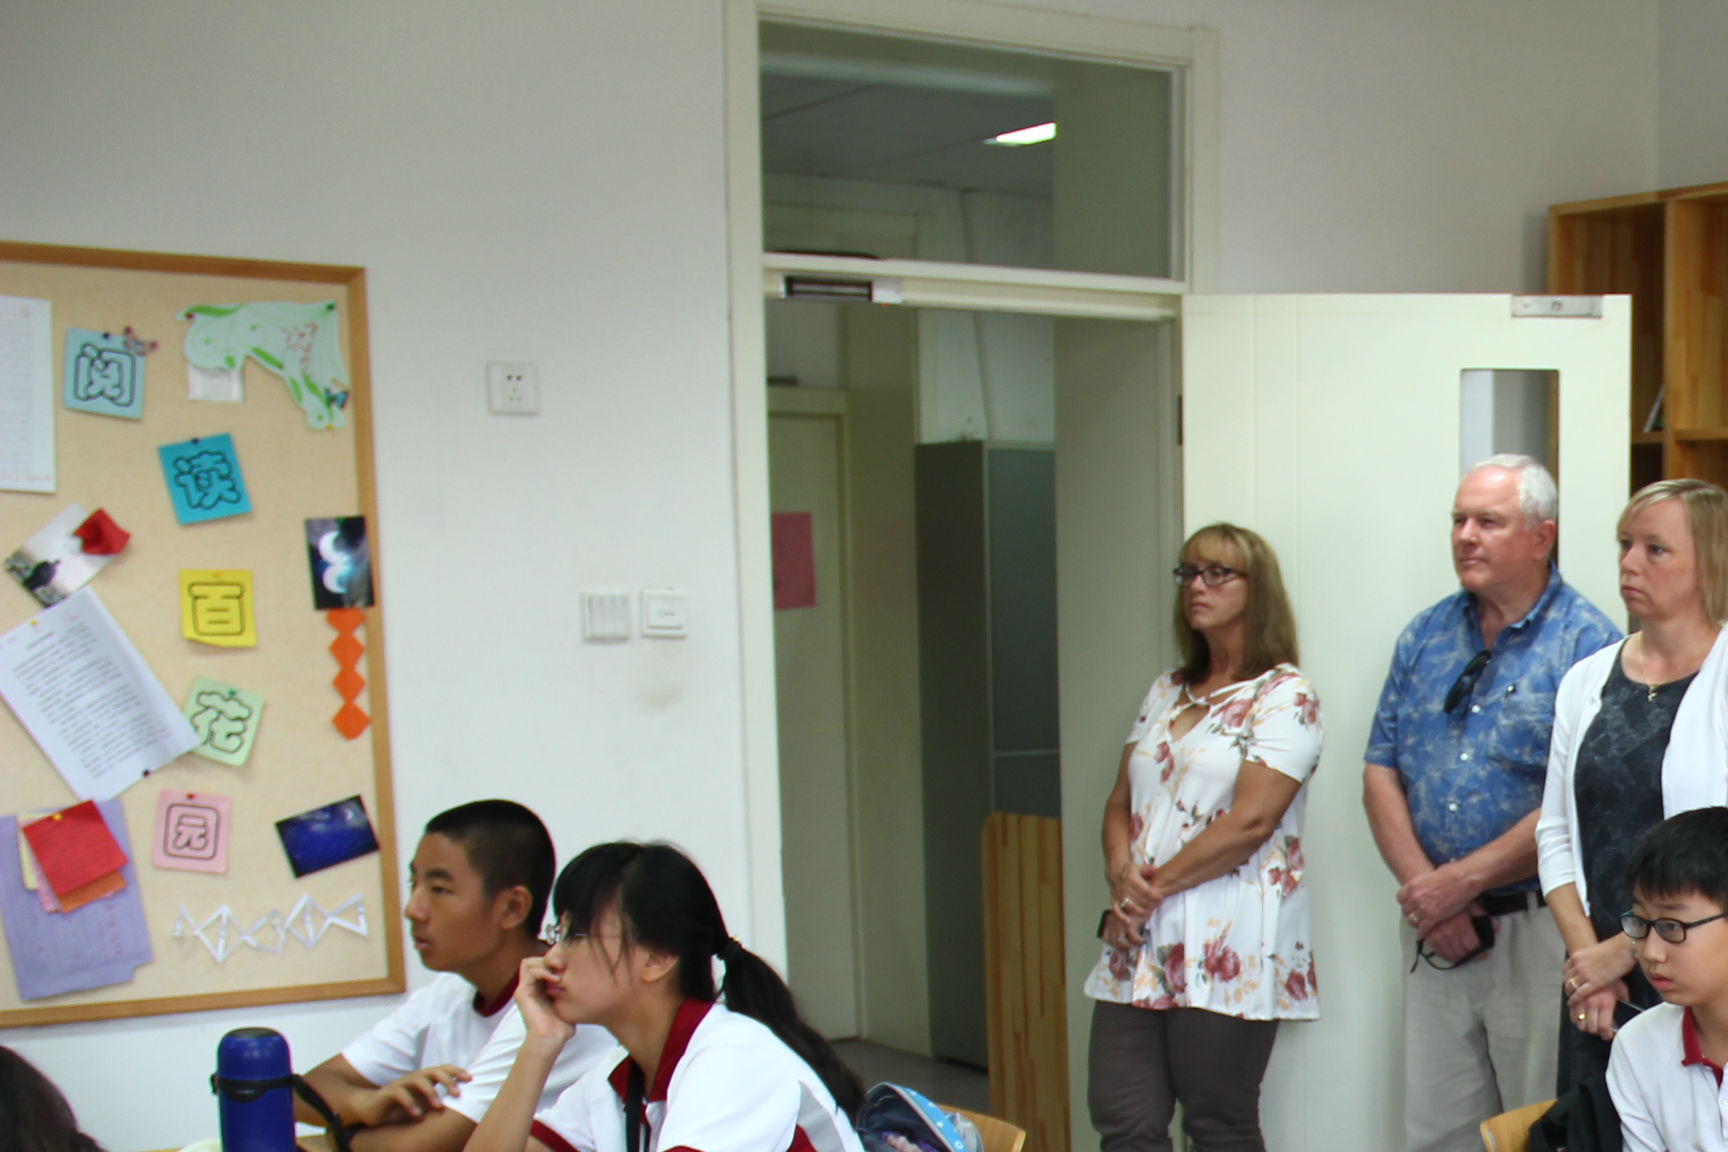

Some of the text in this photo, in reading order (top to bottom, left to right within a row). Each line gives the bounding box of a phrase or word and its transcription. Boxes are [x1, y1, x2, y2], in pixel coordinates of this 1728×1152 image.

[73, 342, 137, 408] 阅
[173, 450, 243, 511] 读
[190, 690, 252, 755] 花
[162, 801, 222, 861] 园
